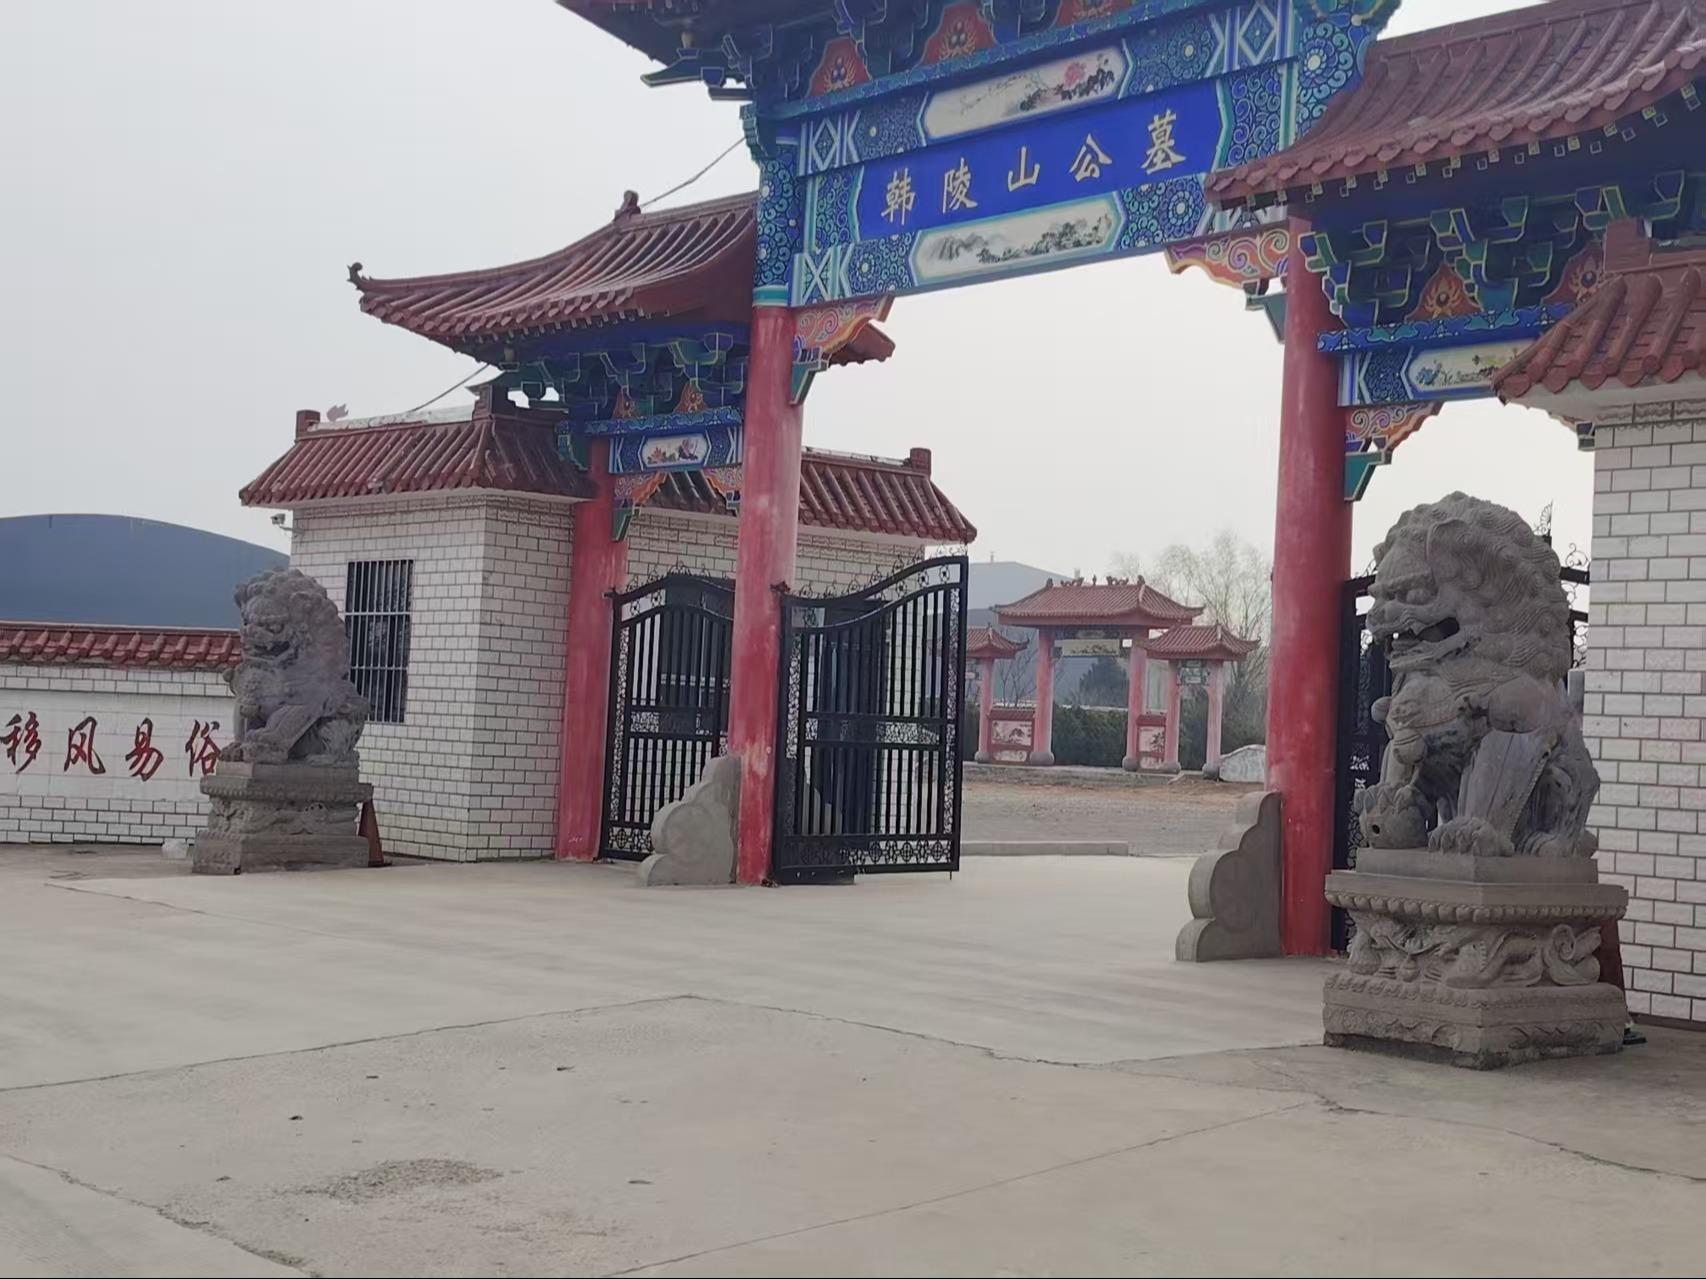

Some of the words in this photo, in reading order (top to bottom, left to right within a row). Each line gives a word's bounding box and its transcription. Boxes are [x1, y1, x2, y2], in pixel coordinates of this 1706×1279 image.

[881, 108, 1187, 225] 韩陵山公墓
[0, 711, 221, 782] 移风易俗
